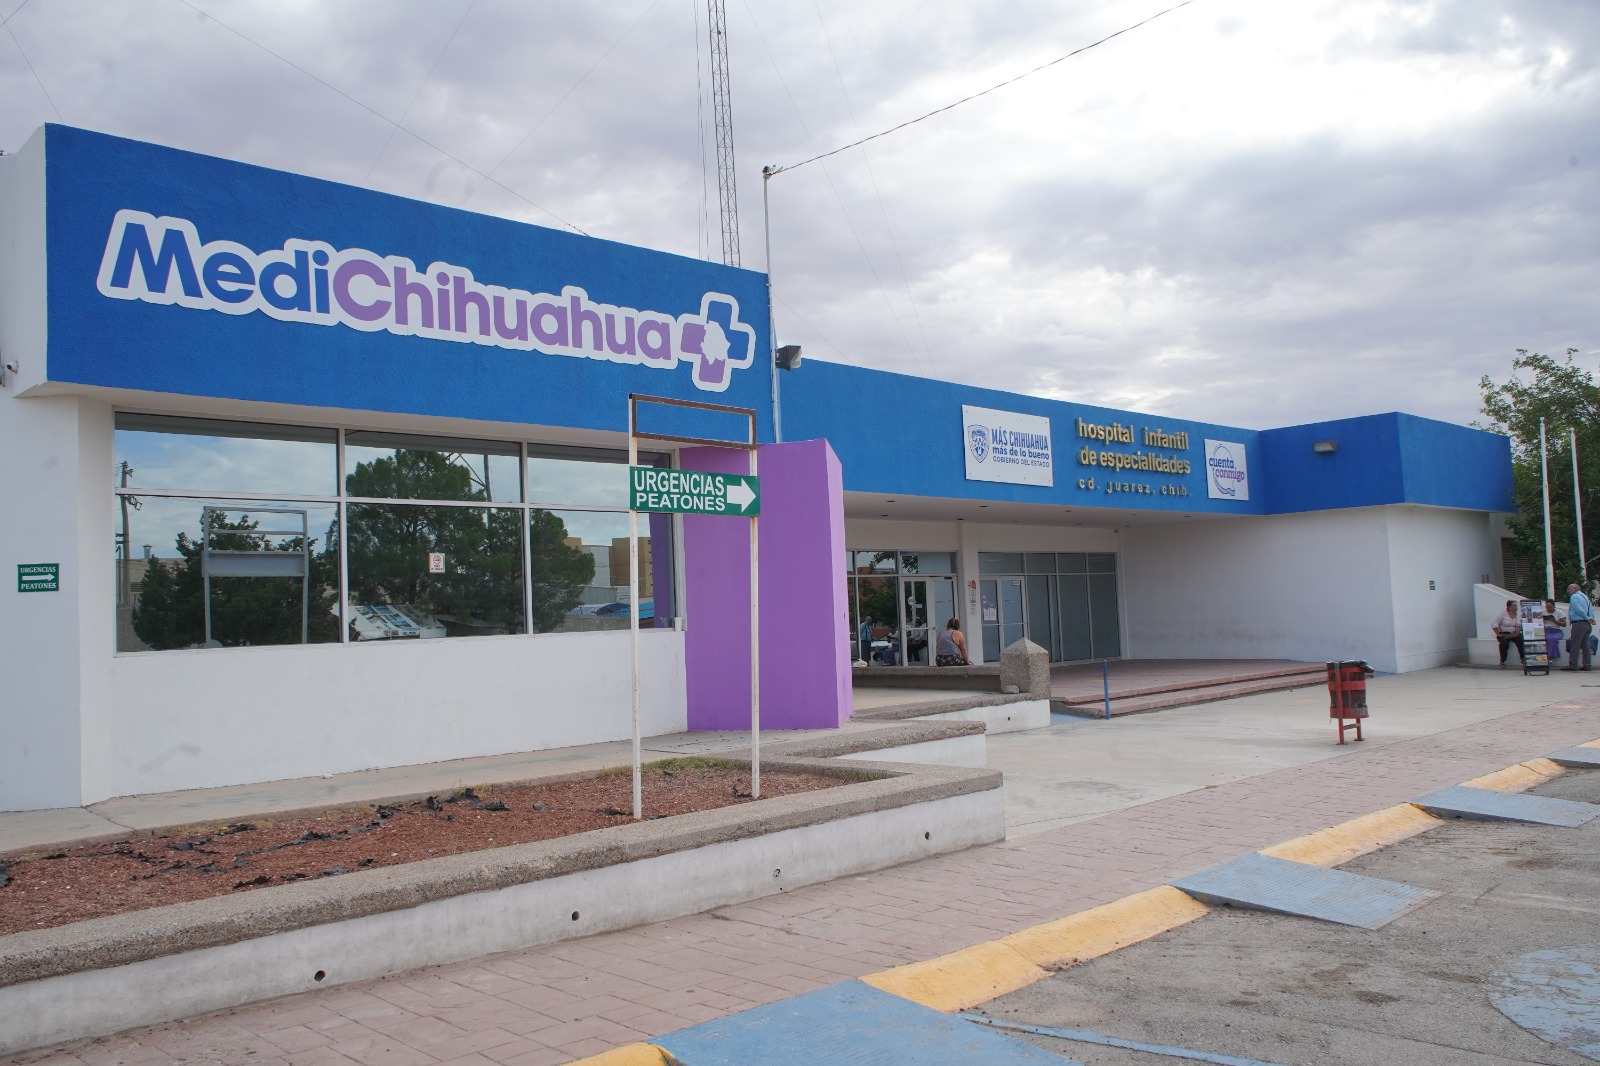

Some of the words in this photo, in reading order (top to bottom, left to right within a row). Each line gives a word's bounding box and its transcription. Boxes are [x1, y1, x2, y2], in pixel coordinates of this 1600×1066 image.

[110, 221, 672, 361] MediChihuahua
[991, 426, 1008, 446] MÁS
[1009, 430, 1049, 451] CHIHUAHUA
[1077, 417, 1135, 446] hospital
[1143, 427, 1190, 450] infantil
[992, 446, 1008, 456] más
[1009, 447, 1019, 457] de
[1020, 448, 1027, 458] lo
[1028, 449, 1050, 460] bueno
[992, 456, 1020, 464] GOBIERNO
[1031, 460, 1050, 468] ESTADO
[1080, 445, 1098, 466] de
[1099, 450, 1191, 474] especialidades
[1208, 457, 1235, 469] cuenta
[634, 470, 725, 496] URGENCIAS
[1215, 467, 1245, 483] conmigo
[636, 492, 726, 512] PEATONES
[20, 582, 57, 590] PEATONES
